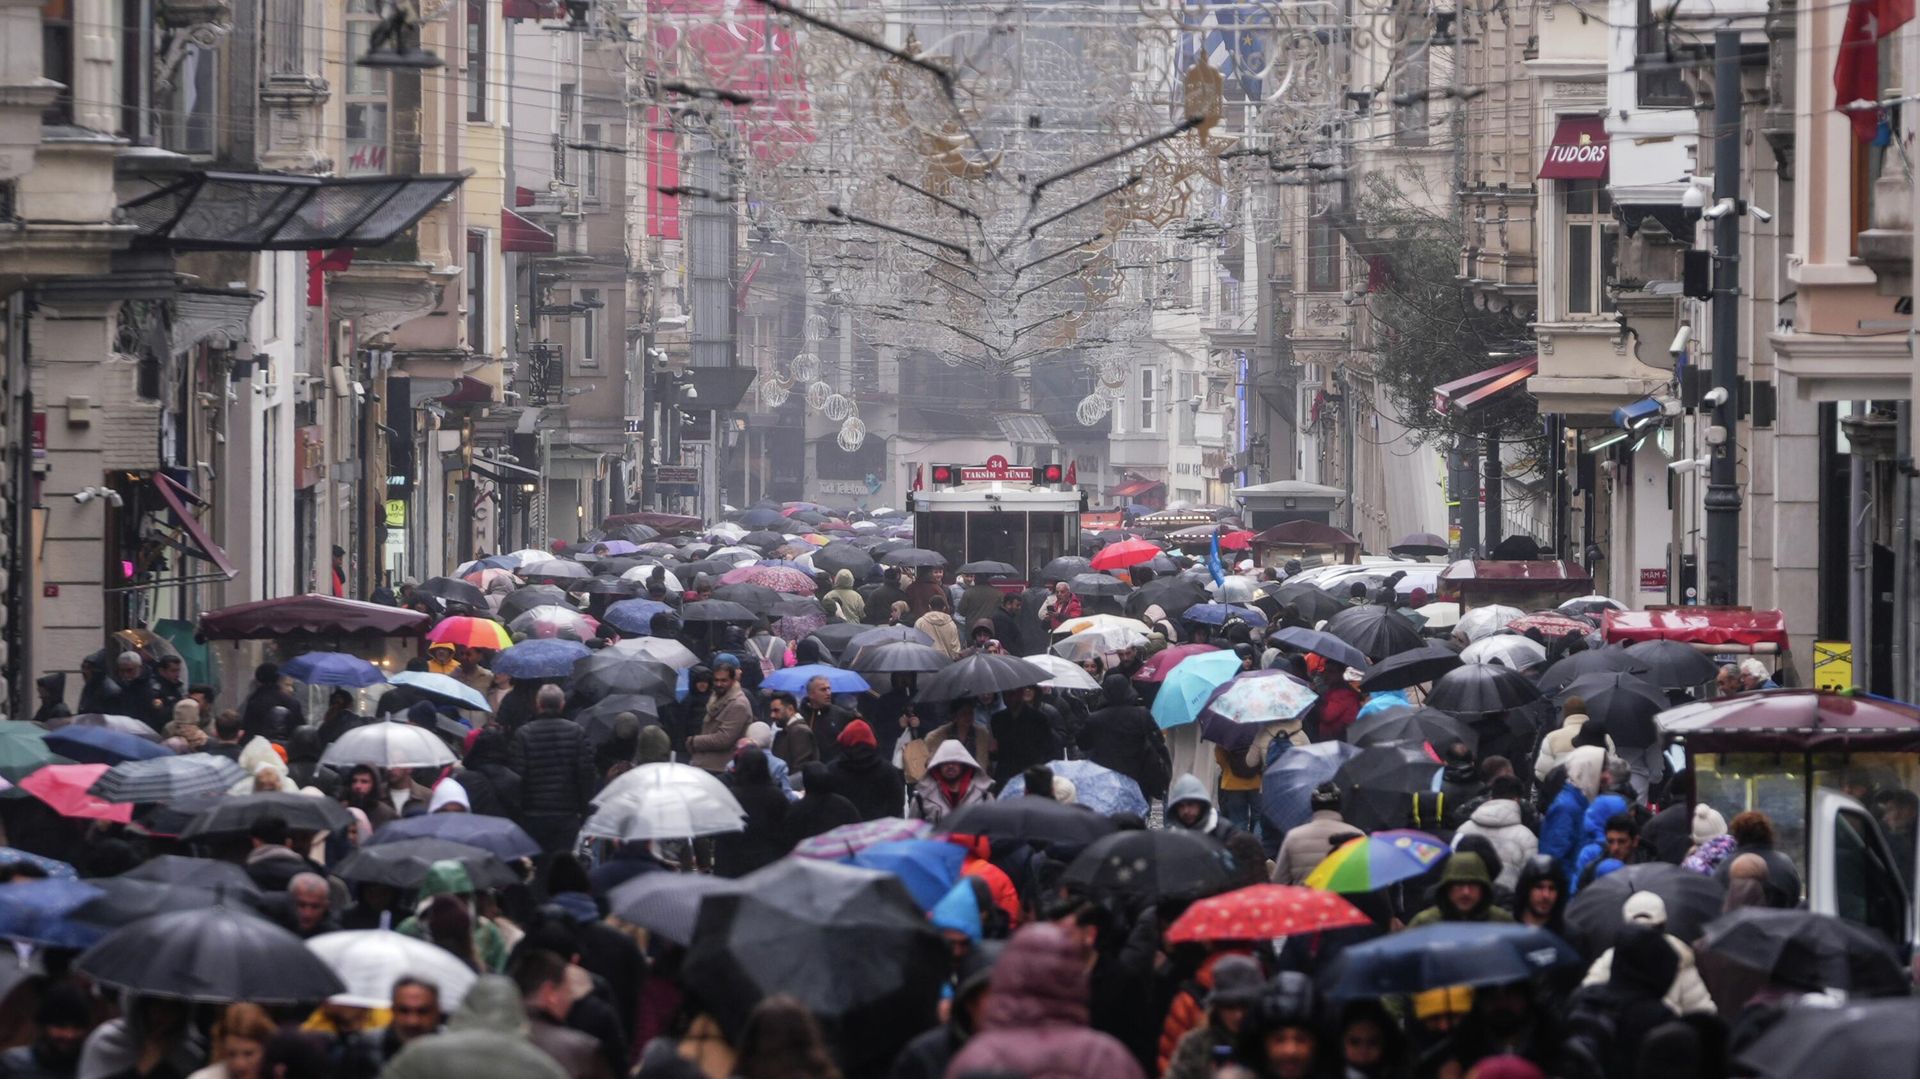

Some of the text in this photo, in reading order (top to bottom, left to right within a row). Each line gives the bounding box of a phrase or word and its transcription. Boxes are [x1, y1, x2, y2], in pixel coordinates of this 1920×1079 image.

[349, 144, 386, 170] H&M
[1550, 145, 1608, 162] TUDORS
[991, 460, 1003, 468] 34
[965, 470, 996, 478] TAKSİM
[1004, 469, 1031, 478] TÜNEL
